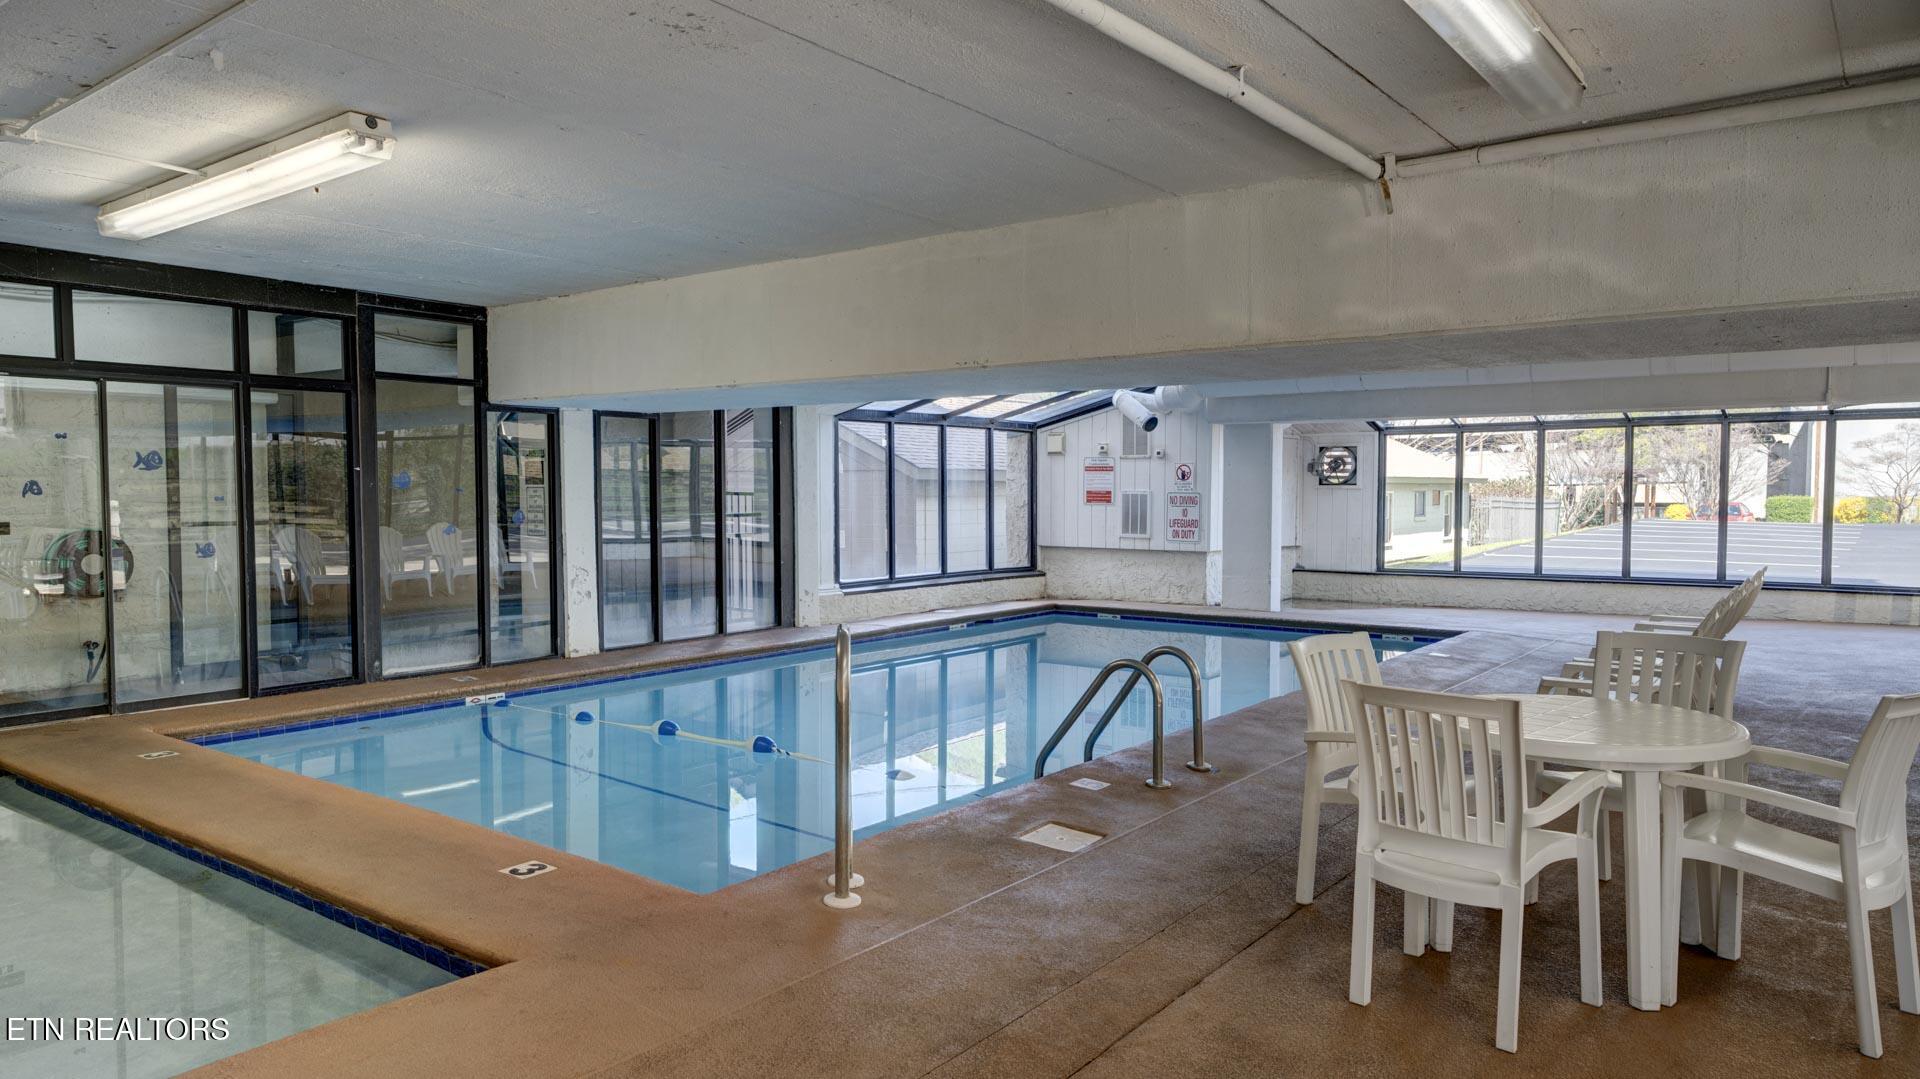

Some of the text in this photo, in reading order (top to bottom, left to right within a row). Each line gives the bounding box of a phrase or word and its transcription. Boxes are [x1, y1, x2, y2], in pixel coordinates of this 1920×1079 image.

[1170, 496, 1198, 505] NO DIVING
[1169, 519, 1198, 528] LIFEGUARD
[1172, 529, 1196, 539] ON DUTY
[508, 863, 548, 876] 3
